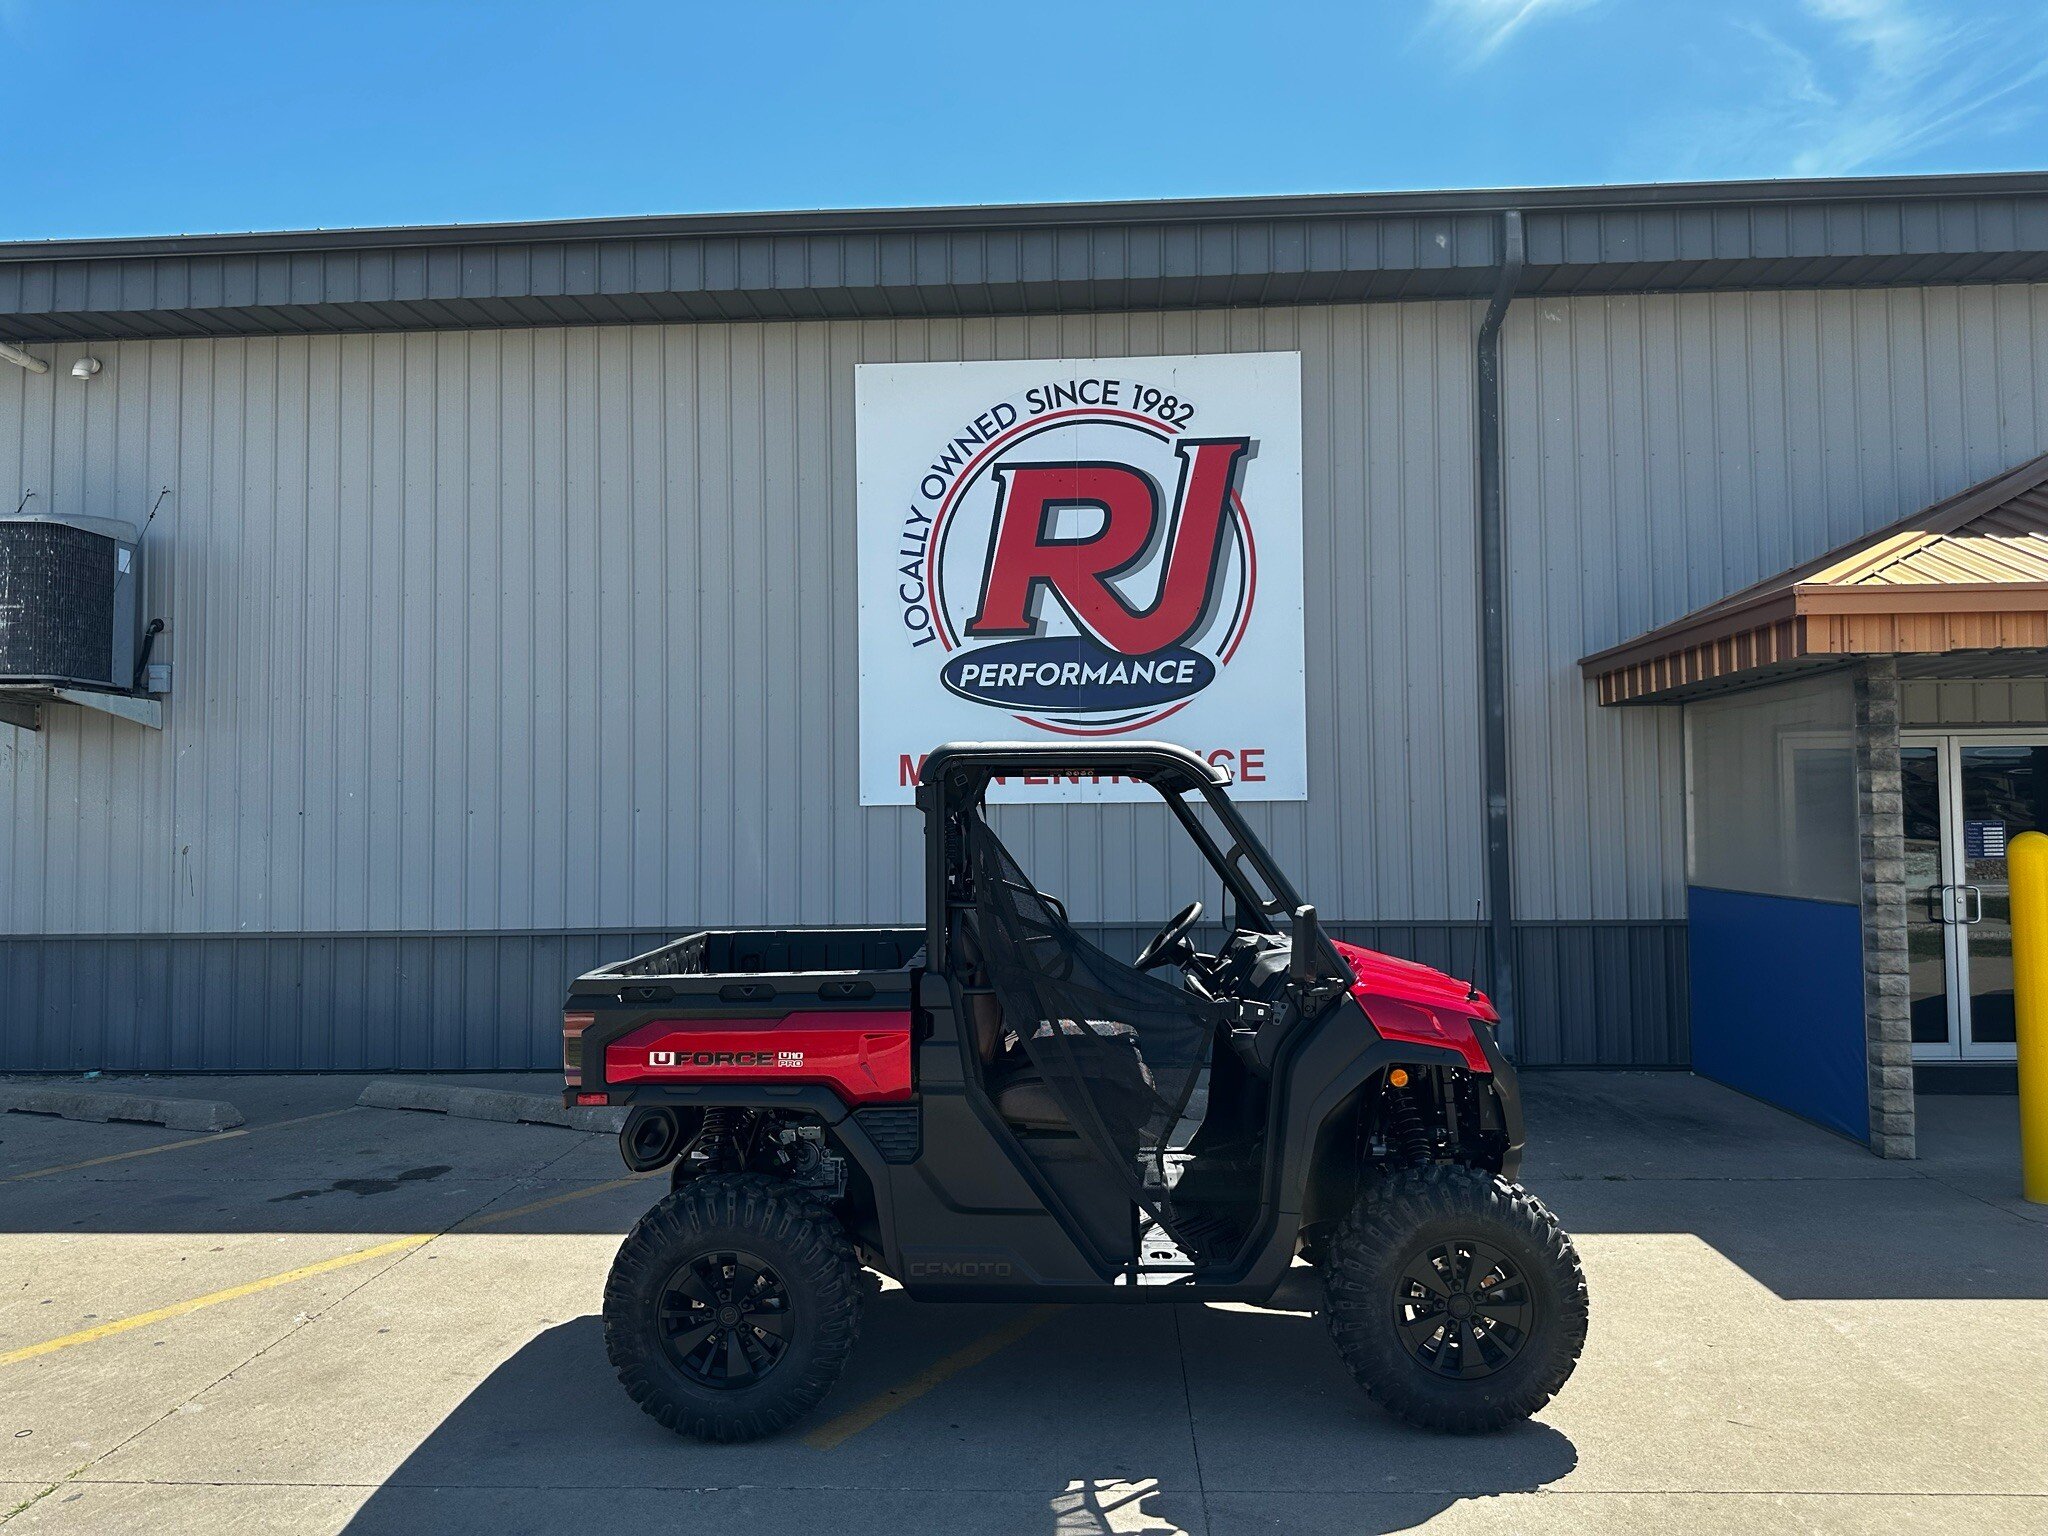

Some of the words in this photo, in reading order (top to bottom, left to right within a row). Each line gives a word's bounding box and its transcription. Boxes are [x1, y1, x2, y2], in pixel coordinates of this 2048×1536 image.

[898, 504, 937, 648] LOCALLY
[920, 402, 1017, 500] OWNED
[1025, 378, 1120, 415] SINCE
[1132, 384, 1195, 430] 1982
[963, 436, 1251, 656] RJ
[958, 658, 1196, 689] PERFORMANCE
[910, 1262, 1011, 1277] CFMOTO
